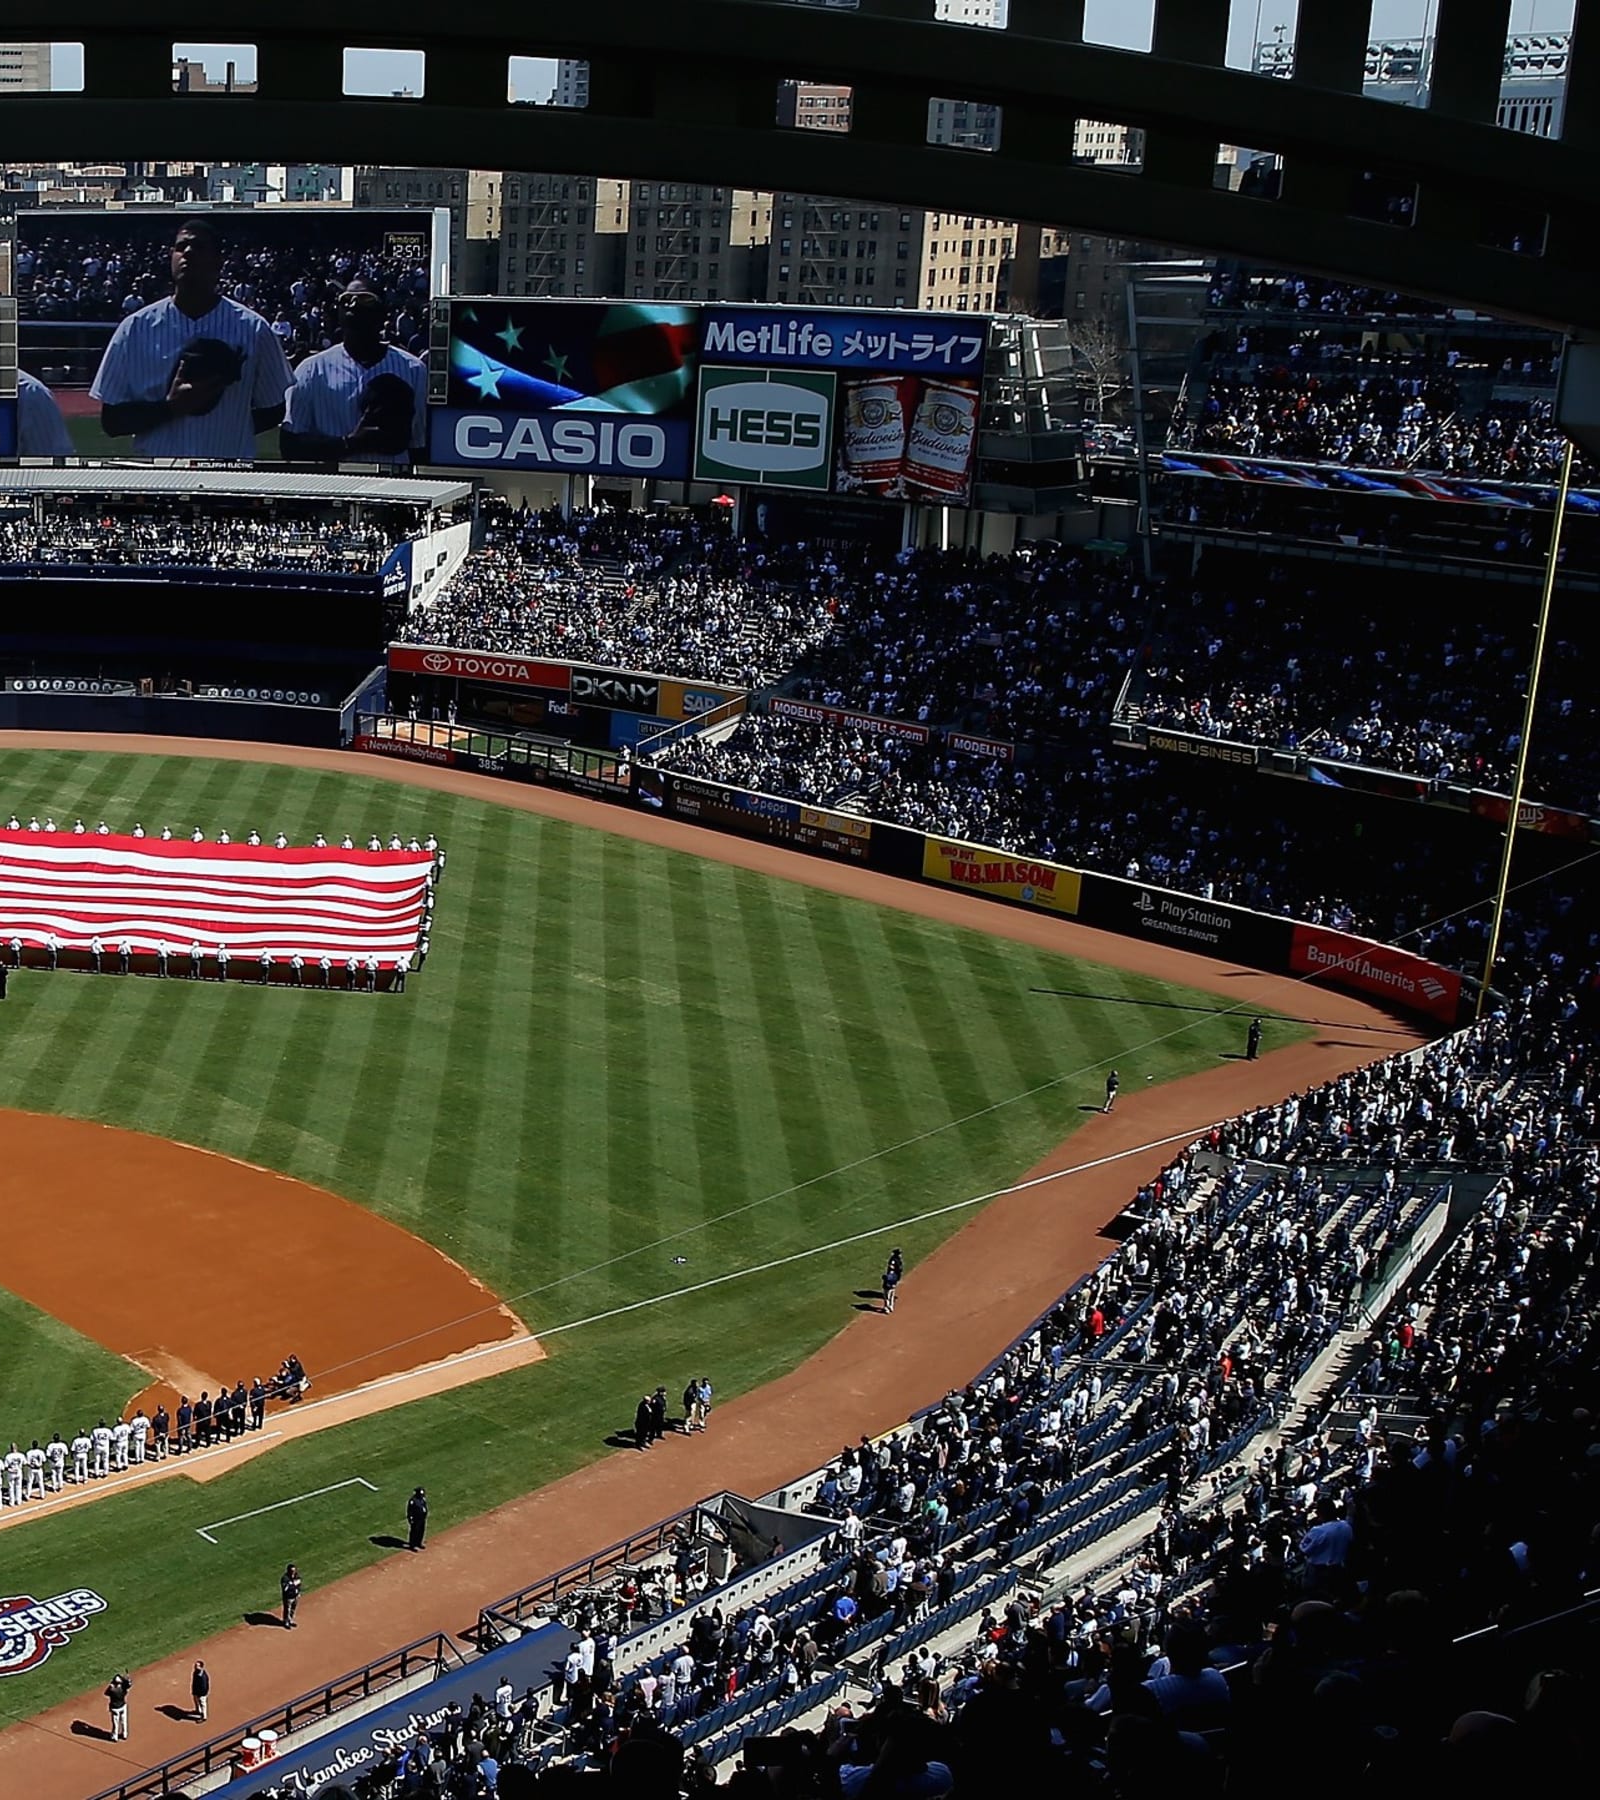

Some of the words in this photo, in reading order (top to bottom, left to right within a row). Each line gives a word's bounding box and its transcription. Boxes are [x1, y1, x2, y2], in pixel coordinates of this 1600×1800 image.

[704, 320, 832, 357] MetLife
[842, 330, 983, 365] メットライフ
[709, 407, 821, 448] HESS
[454, 415, 666, 468] CASIO
[455, 657, 529, 679] TOYOTA
[572, 675, 658, 704] DKNY
[548, 700, 581, 717] FedEx
[683, 694, 717, 712] SAP
[774, 701, 824, 724] MODELL'S
[953, 738, 1008, 758] MODELL'S
[1178, 741, 1253, 765] BUSINESS
[760, 799, 788, 814] pepsi
[1161, 900, 1232, 929] PlayStation
[1141, 917, 1187, 936] GREATNESS
[1187, 929, 1219, 943] AWAITS
[1307, 945, 1346, 967] Bank
[1346, 957, 1361, 973] of
[1361, 962, 1416, 993] America
